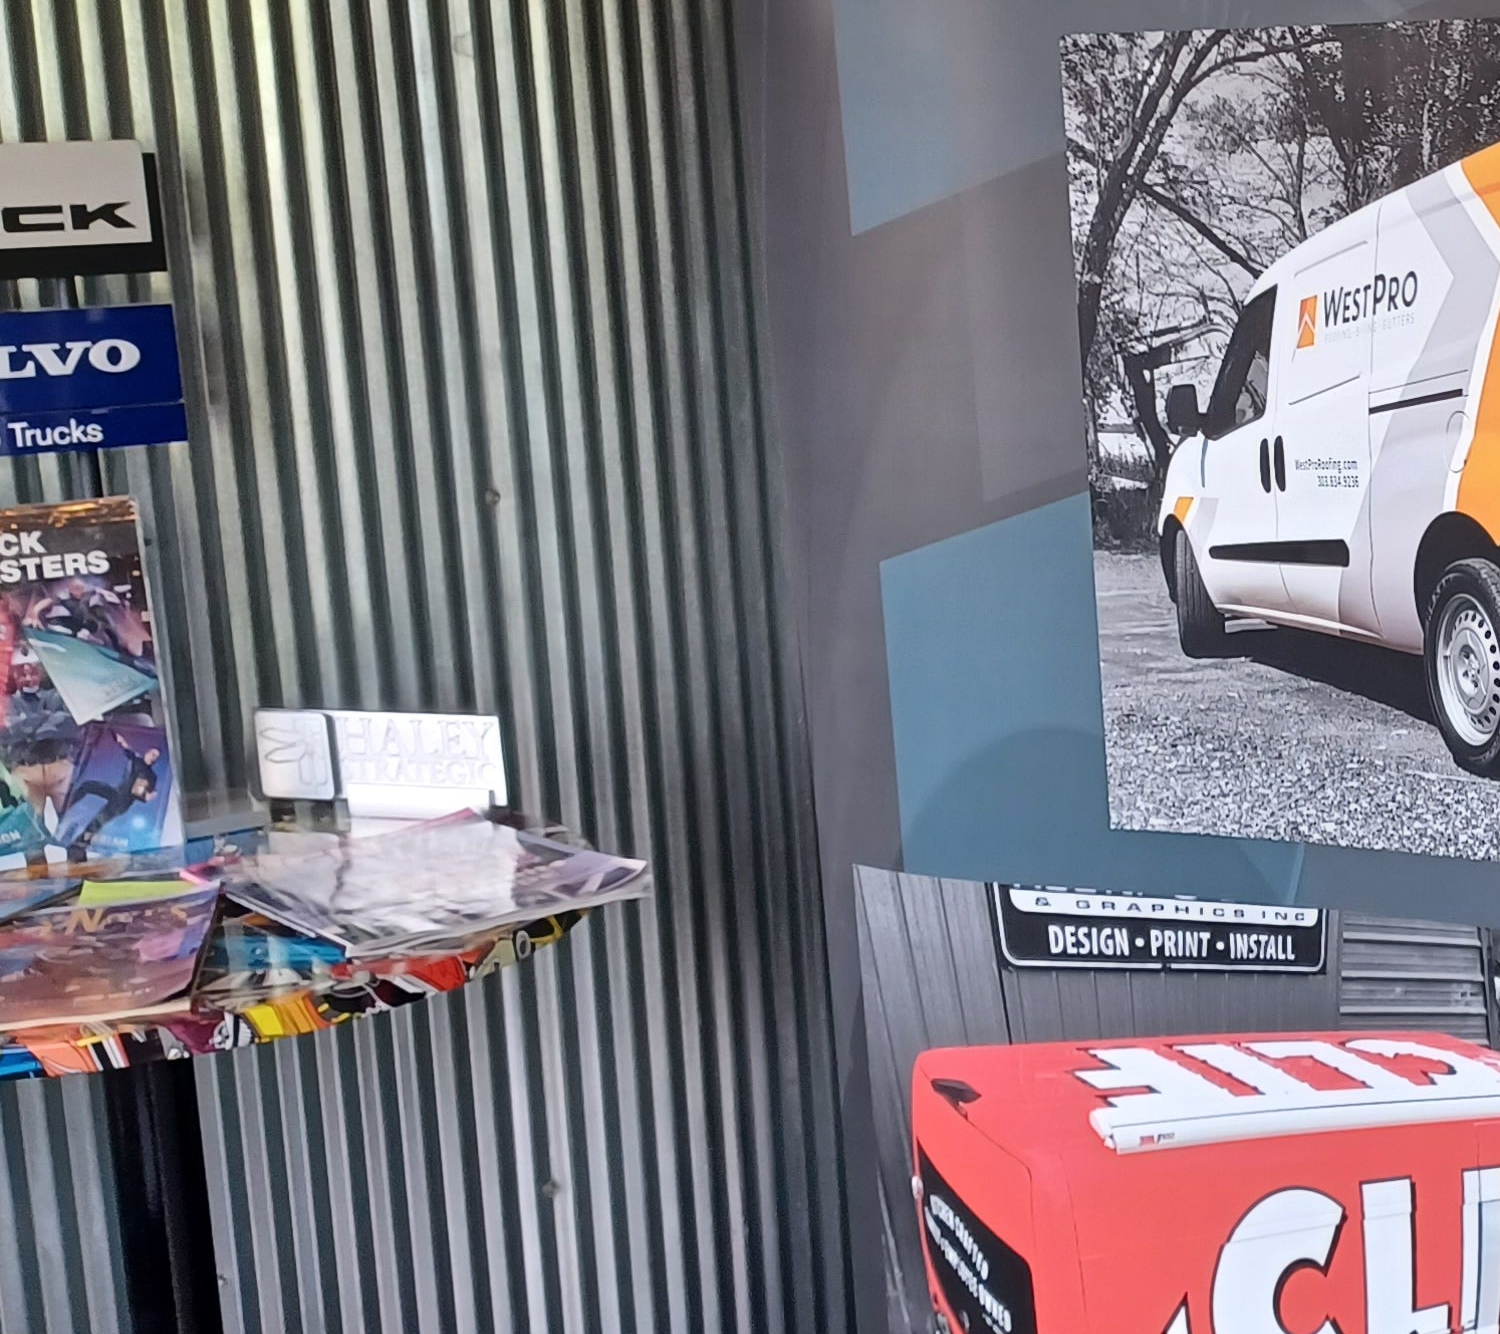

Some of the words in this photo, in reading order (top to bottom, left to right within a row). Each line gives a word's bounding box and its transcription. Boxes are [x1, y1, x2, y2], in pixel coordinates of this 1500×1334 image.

[7, 418, 104, 448] Trucks
[335, 717, 495, 762] HALEY
[1035, 896, 1051, 907] &
[1076, 898, 1245, 919] GRAPHICS
[1262, 909, 1305, 921] INC
[1048, 925, 1130, 956] DESIGN
[1150, 929, 1211, 958] PRINT
[1229, 933, 1296, 961] INSTALL
